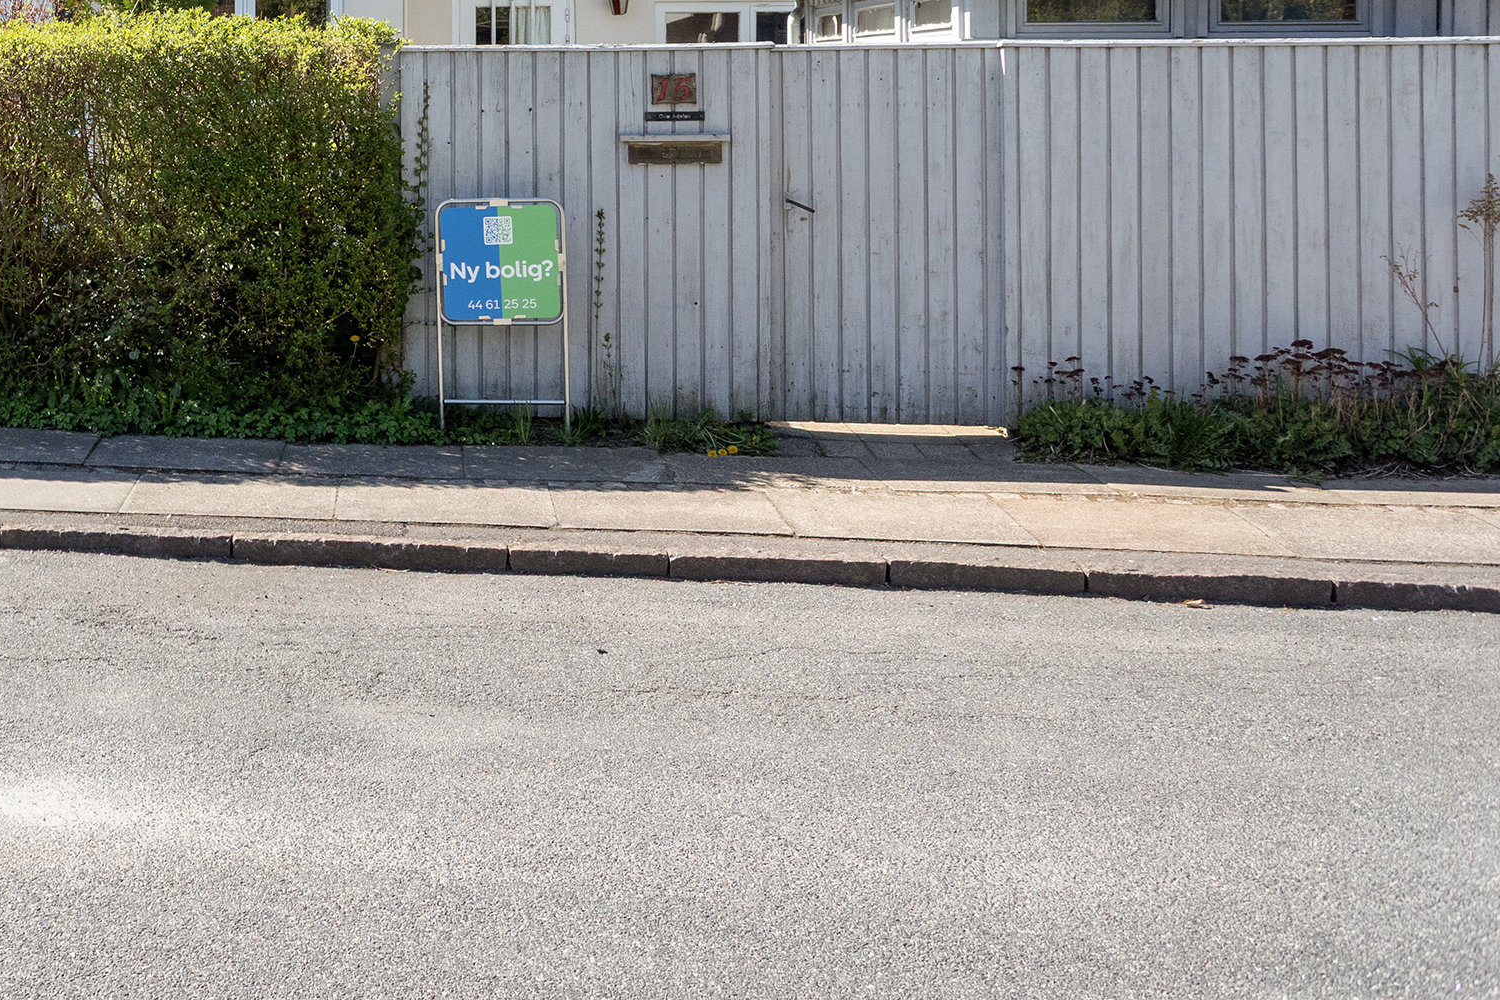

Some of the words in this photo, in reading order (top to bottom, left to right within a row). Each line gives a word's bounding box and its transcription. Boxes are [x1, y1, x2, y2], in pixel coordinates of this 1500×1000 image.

[657, 77, 693, 101] 15
[450, 262, 480, 283] Ny
[485, 260, 554, 281] bolig?
[468, 300, 483, 310] 44
[485, 300, 500, 310] 61
[504, 299, 519, 309] 25
[522, 299, 537, 309] 25
